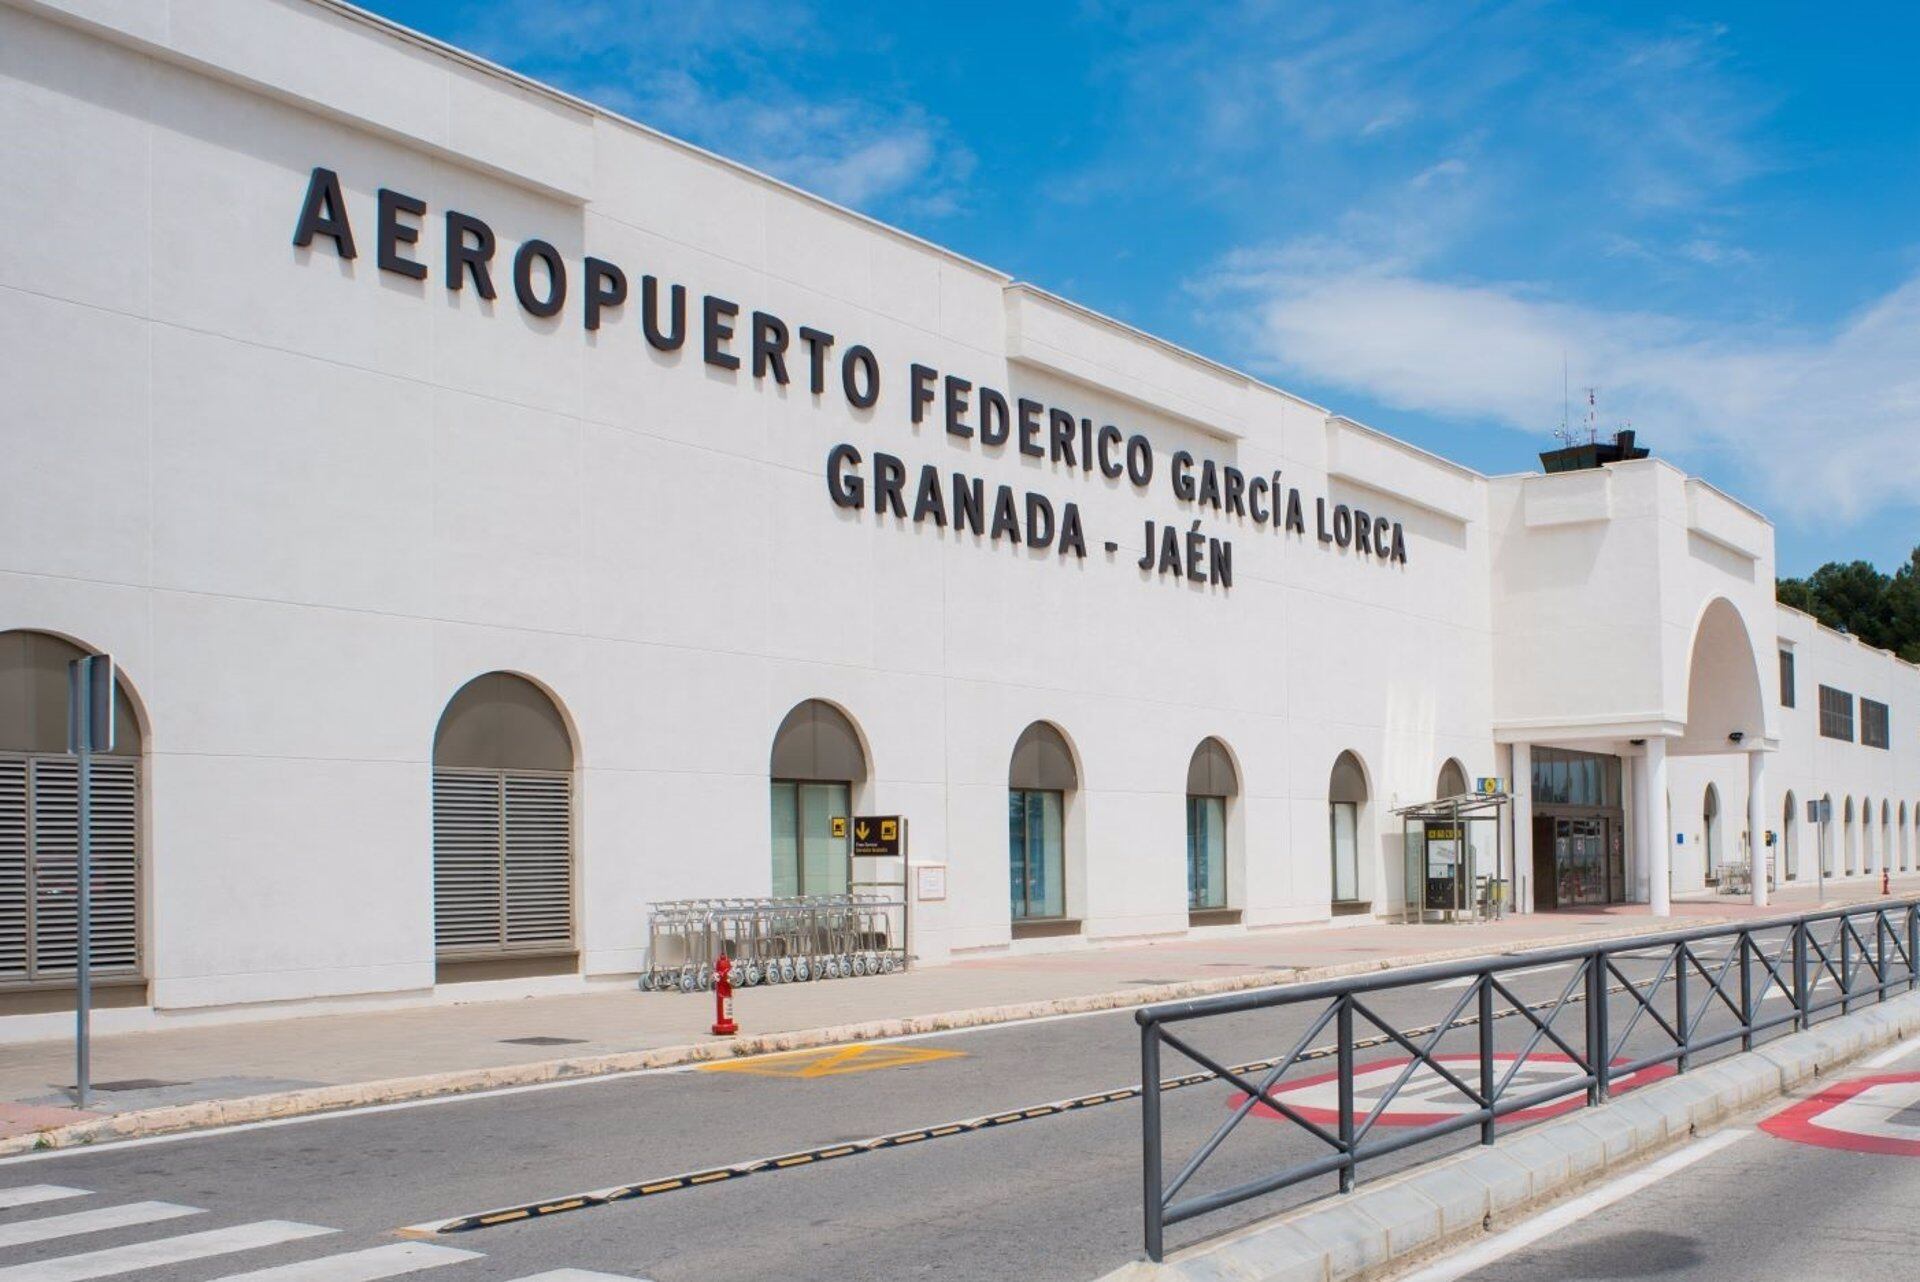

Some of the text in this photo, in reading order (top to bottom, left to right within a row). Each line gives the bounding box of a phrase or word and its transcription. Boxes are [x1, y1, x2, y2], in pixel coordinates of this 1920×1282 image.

[293, 167, 1407, 565] AEROPUERTO FEDERICO GARCÍA LORCA
[827, 443, 1087, 559] GRANADA
[1138, 520, 1232, 589] JAÉN
